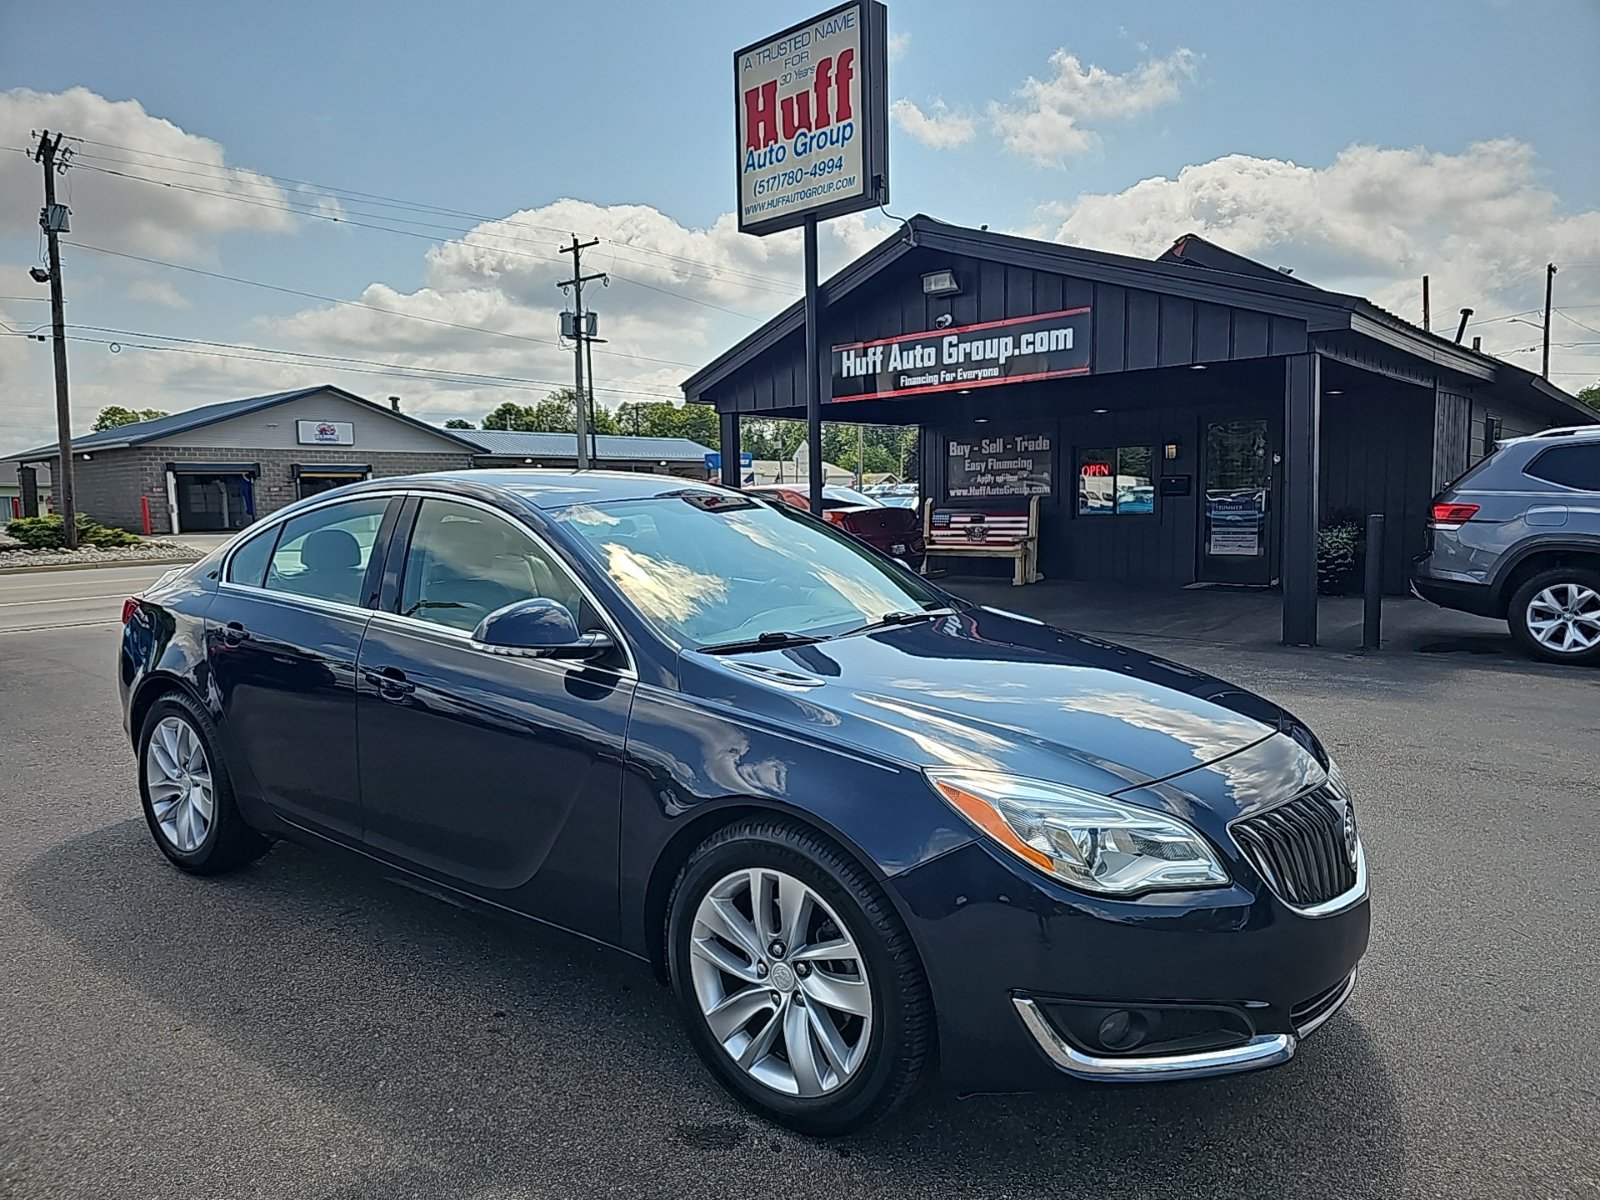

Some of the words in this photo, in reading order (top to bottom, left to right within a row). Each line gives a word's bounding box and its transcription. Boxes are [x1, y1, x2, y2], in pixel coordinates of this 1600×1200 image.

[744, 57, 753, 72] A
[755, 31, 811, 65] TRUSTED
[814, 11, 856, 42] NAME
[780, 73, 792, 86] 30
[793, 64, 815, 83] Years
[784, 51, 810, 69] FOR
[744, 48, 854, 151] Huff
[744, 143, 787, 173] Auto
[793, 121, 854, 158] Group
[753, 155, 844, 198] (517)780-4994
[744, 176, 856, 216] WWW.HUFFAUTOGROUP.COM
[841, 344, 883, 378] Huff
[888, 342, 936, 373] Auto
[942, 327, 1074, 365] Group.com
[900, 372, 939, 387] Financing
[940, 370, 956, 383] For
[957, 367, 999, 381] Everyone
[949, 441, 971, 458] Buy
[981, 438, 1004, 454] Sell
[1014, 435, 1050, 452] Trade
[964, 459, 986, 472] Easy
[987, 457, 1033, 471] Financing
[1081, 464, 1109, 477] OPEN
